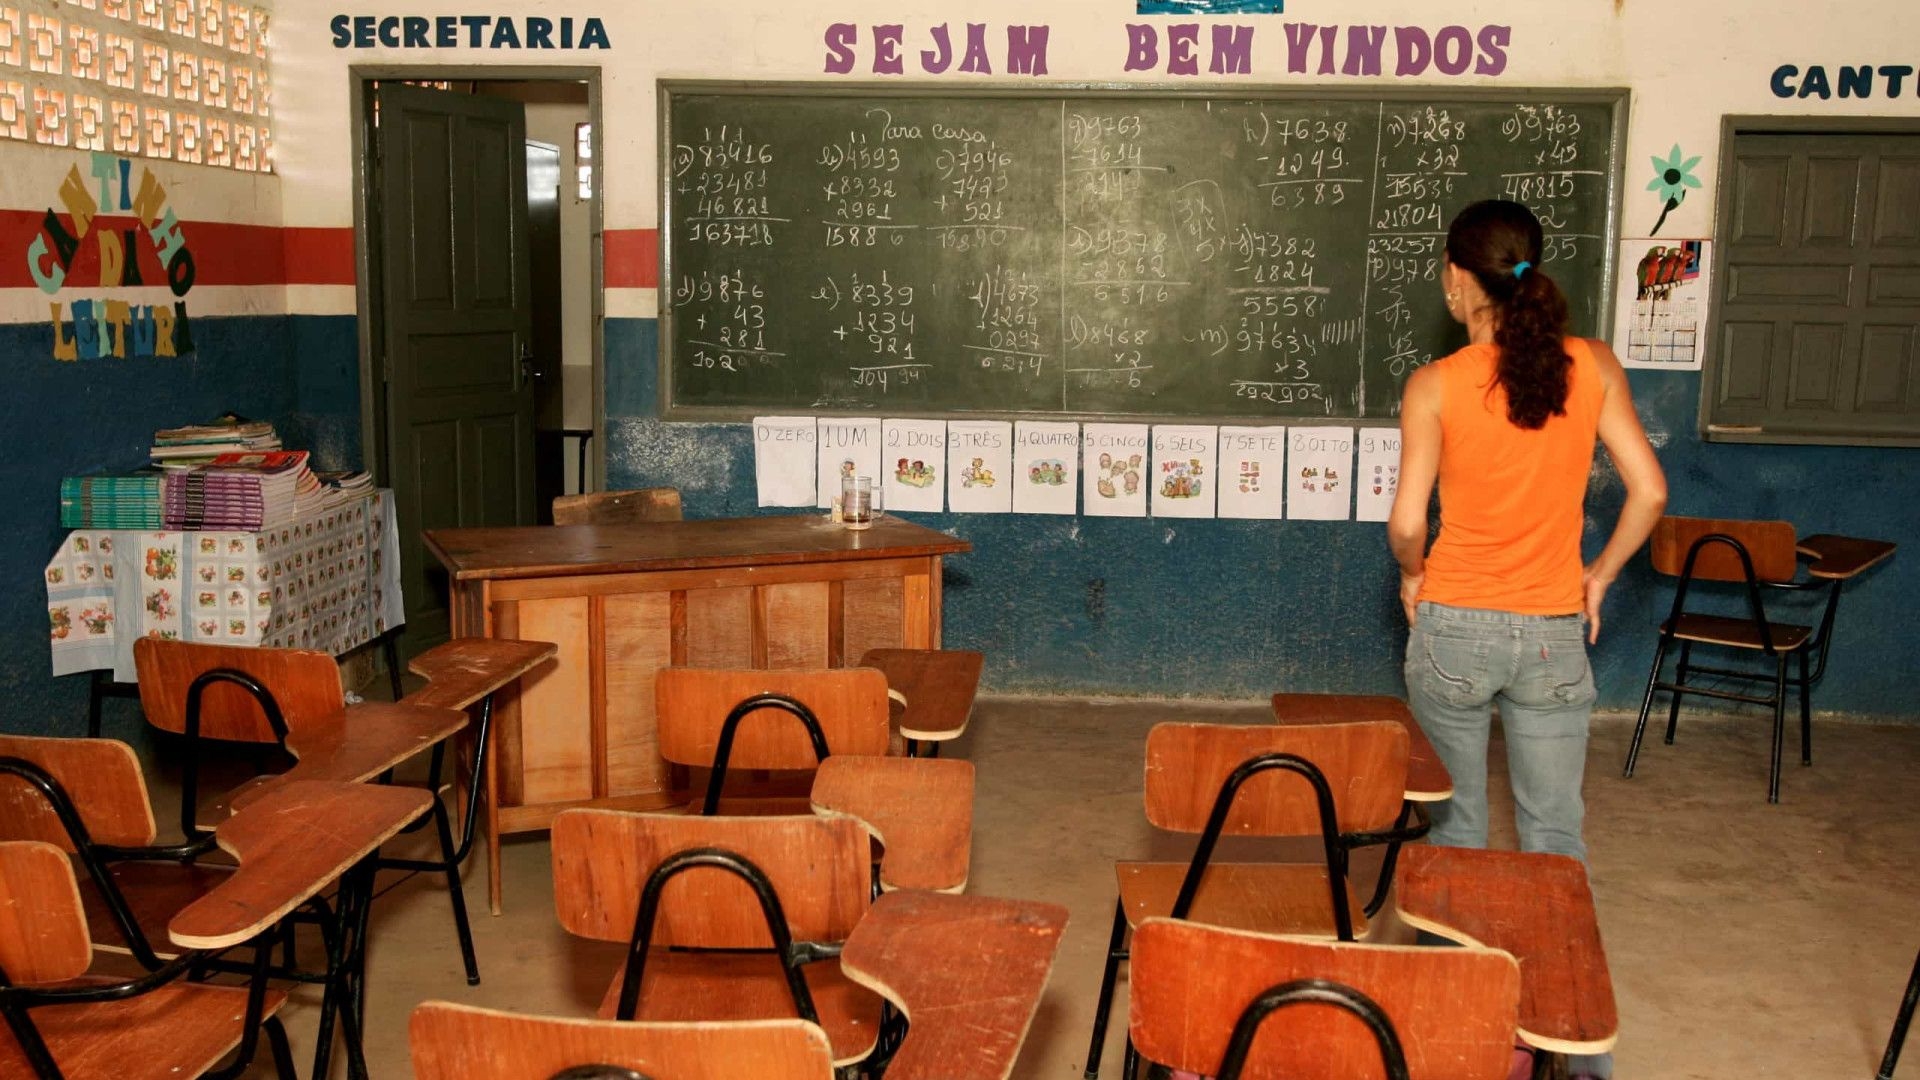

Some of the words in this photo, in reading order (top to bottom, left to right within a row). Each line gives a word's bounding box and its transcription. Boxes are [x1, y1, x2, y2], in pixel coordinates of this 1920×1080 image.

[330, 14, 611, 50] SECRETARIA
[824, 22, 1050, 76] SEJAM
[1124, 23, 1254, 75] BEM
[1283, 23, 1511, 77] VINDOS
[1770, 64, 1920, 100] CANT
[866, 108, 923, 142] Para
[699, 142, 773, 168] 83416
[846, 146, 900, 172] 4593
[959, 149, 1012, 174] 7946
[841, 176, 896, 198] 8332
[837, 200, 892, 220] 2961
[964, 201, 1003, 222] 521
[97, 229, 143, 288] DA
[700, 275, 763, 303] 9876
[734, 304, 765, 328] 43
[853, 310, 914, 334] 1234
[50, 299, 195, 362] LEITURA
[720, 326, 767, 350] 281
[869, 334, 915, 360] 921
[775, 428, 814, 443] ZERO
[837, 427, 868, 448] UM
[907, 430, 942, 448] DOIS
[964, 431, 1001, 448] TRÊS
[1018, 431, 1027, 447] 4
[1029, 431, 1078, 447] QUATRO
[1086, 434, 1095, 447] 5
[1099, 434, 1146, 448] CINCO
[1154, 435, 1164, 451] 6
[1238, 435, 1276, 451] SETE
[1309, 438, 1349, 453] OITO
